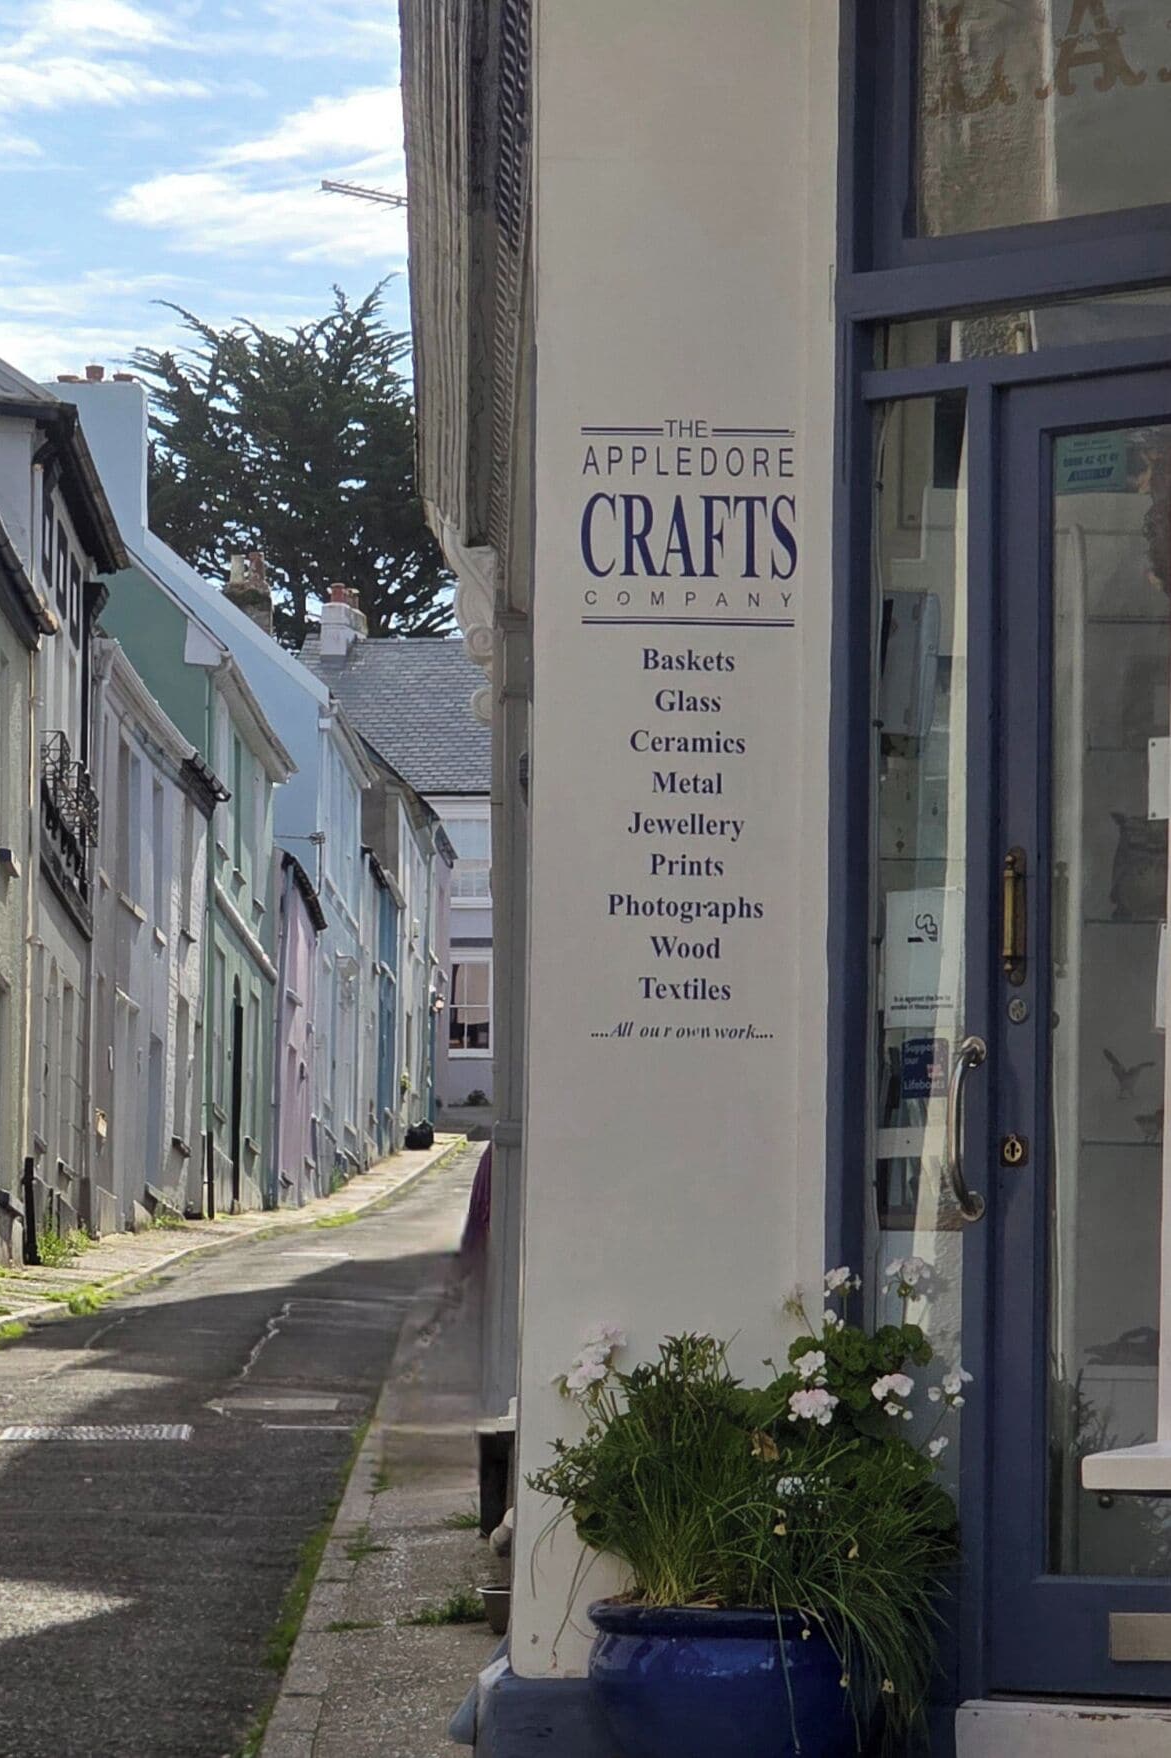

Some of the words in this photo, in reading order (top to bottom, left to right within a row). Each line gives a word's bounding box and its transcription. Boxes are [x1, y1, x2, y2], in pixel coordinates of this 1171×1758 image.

[664, 419, 709, 439] THE
[582, 445, 795, 477] APPLEDORE
[580, 492, 798, 580] CRAFTS
[584, 590, 792, 608] COMPANY
[642, 648, 736, 673] Baskets
[655, 689, 722, 713] Glass
[630, 730, 746, 755] Ceramics
[652, 771, 723, 796] Metal
[627, 812, 745, 842] Jewellery
[650, 853, 724, 877] Prints
[608, 894, 764, 924] Photographs
[650, 936, 721, 960] Wood
[638, 977, 732, 1001] Textiles
[639, 1025, 672, 1039] our
